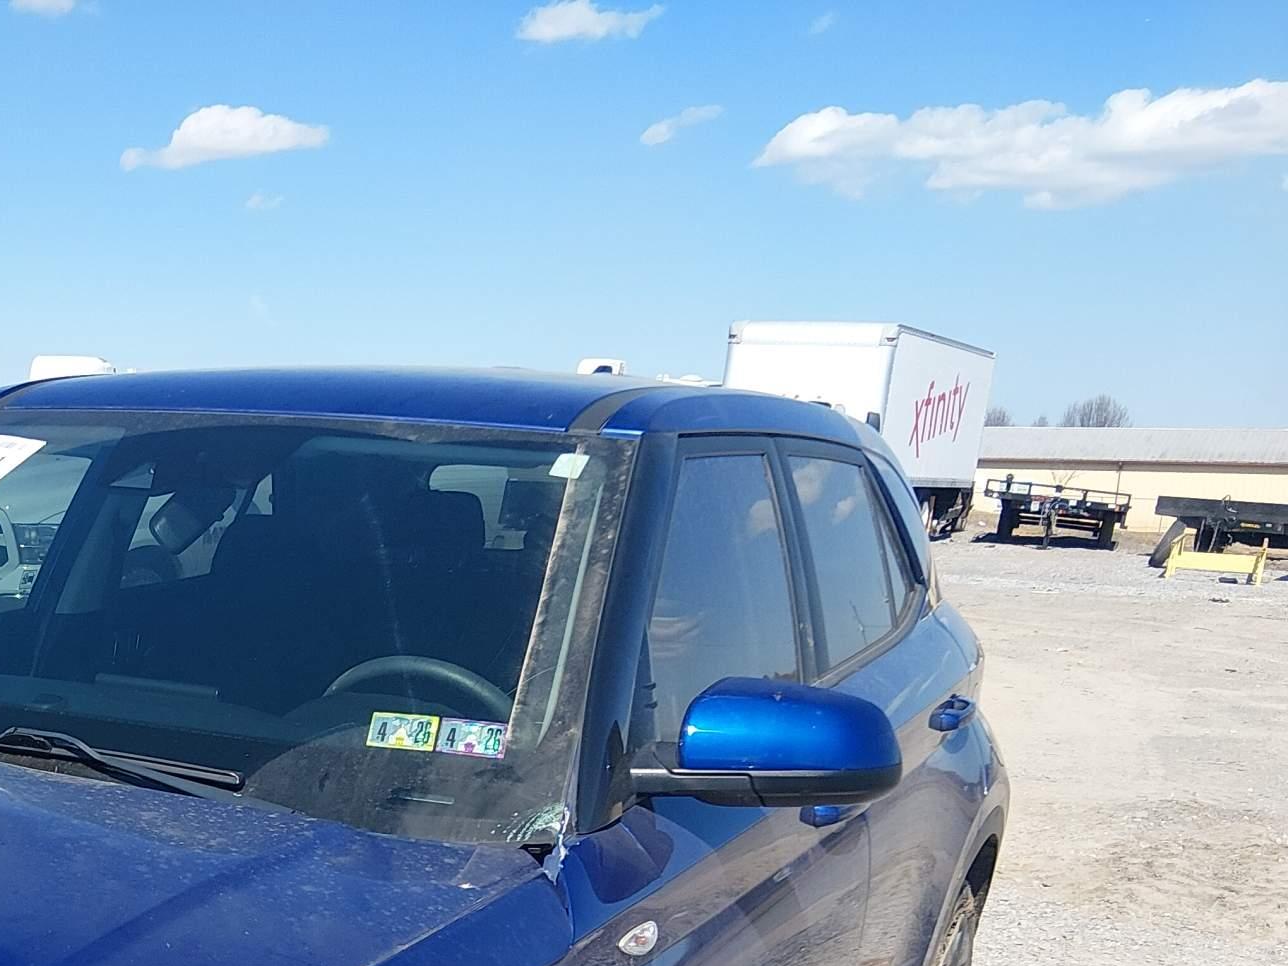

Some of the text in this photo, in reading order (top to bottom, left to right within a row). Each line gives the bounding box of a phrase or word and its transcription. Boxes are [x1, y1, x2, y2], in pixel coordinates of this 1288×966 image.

[909, 373, 970, 458] xfinity
[377, 721, 388, 742] 4
[447, 727, 502, 751] 4 26
